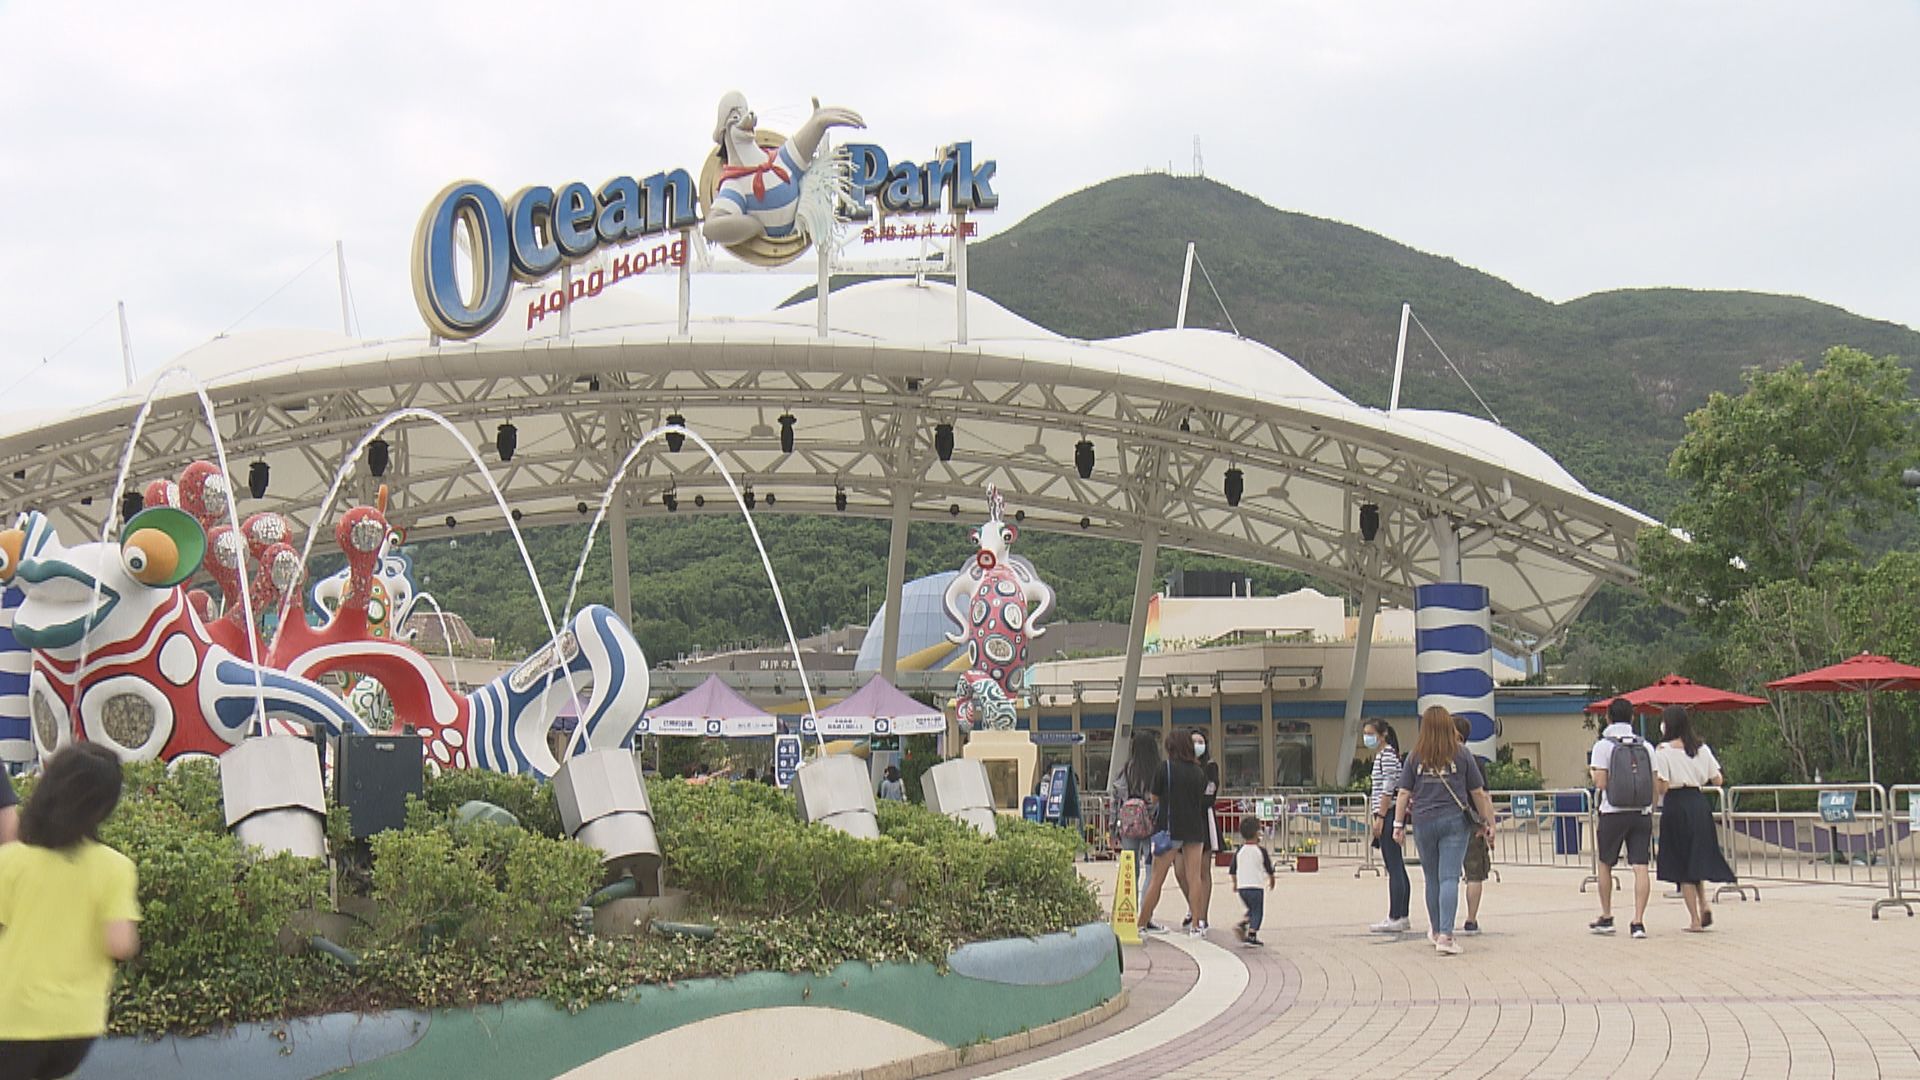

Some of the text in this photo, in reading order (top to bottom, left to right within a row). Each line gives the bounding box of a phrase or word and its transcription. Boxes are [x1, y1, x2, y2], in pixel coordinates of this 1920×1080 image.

[411, 140, 999, 339] Ocean Park
[862, 222, 977, 244] 香港海洋公園
[527, 239, 688, 331] Hong Kong
